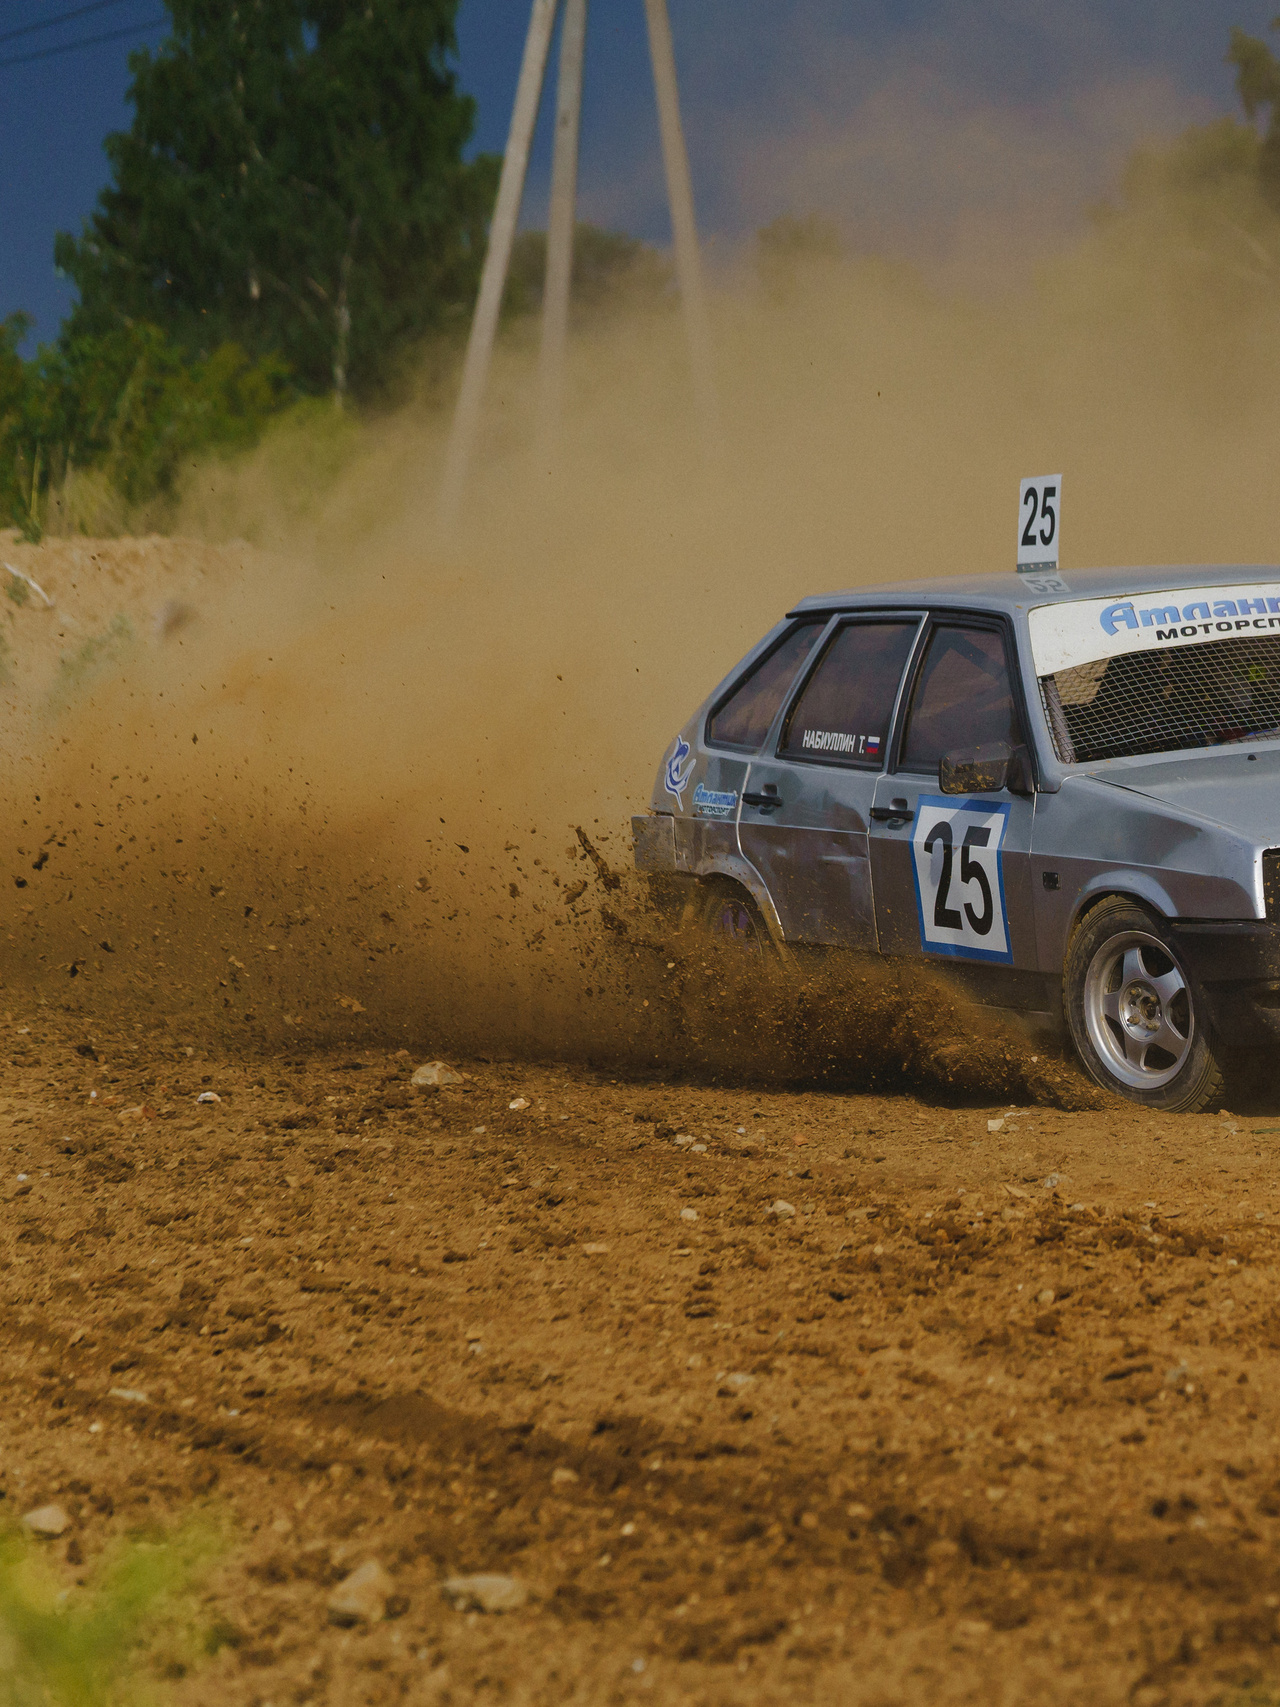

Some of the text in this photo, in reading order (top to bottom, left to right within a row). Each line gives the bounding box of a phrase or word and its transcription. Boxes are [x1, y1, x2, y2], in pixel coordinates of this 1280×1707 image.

[1021, 486, 1056, 546] 25
[802, 729, 865, 754] НАБИУЛЛИН Т.
[923, 820, 994, 936] 25
